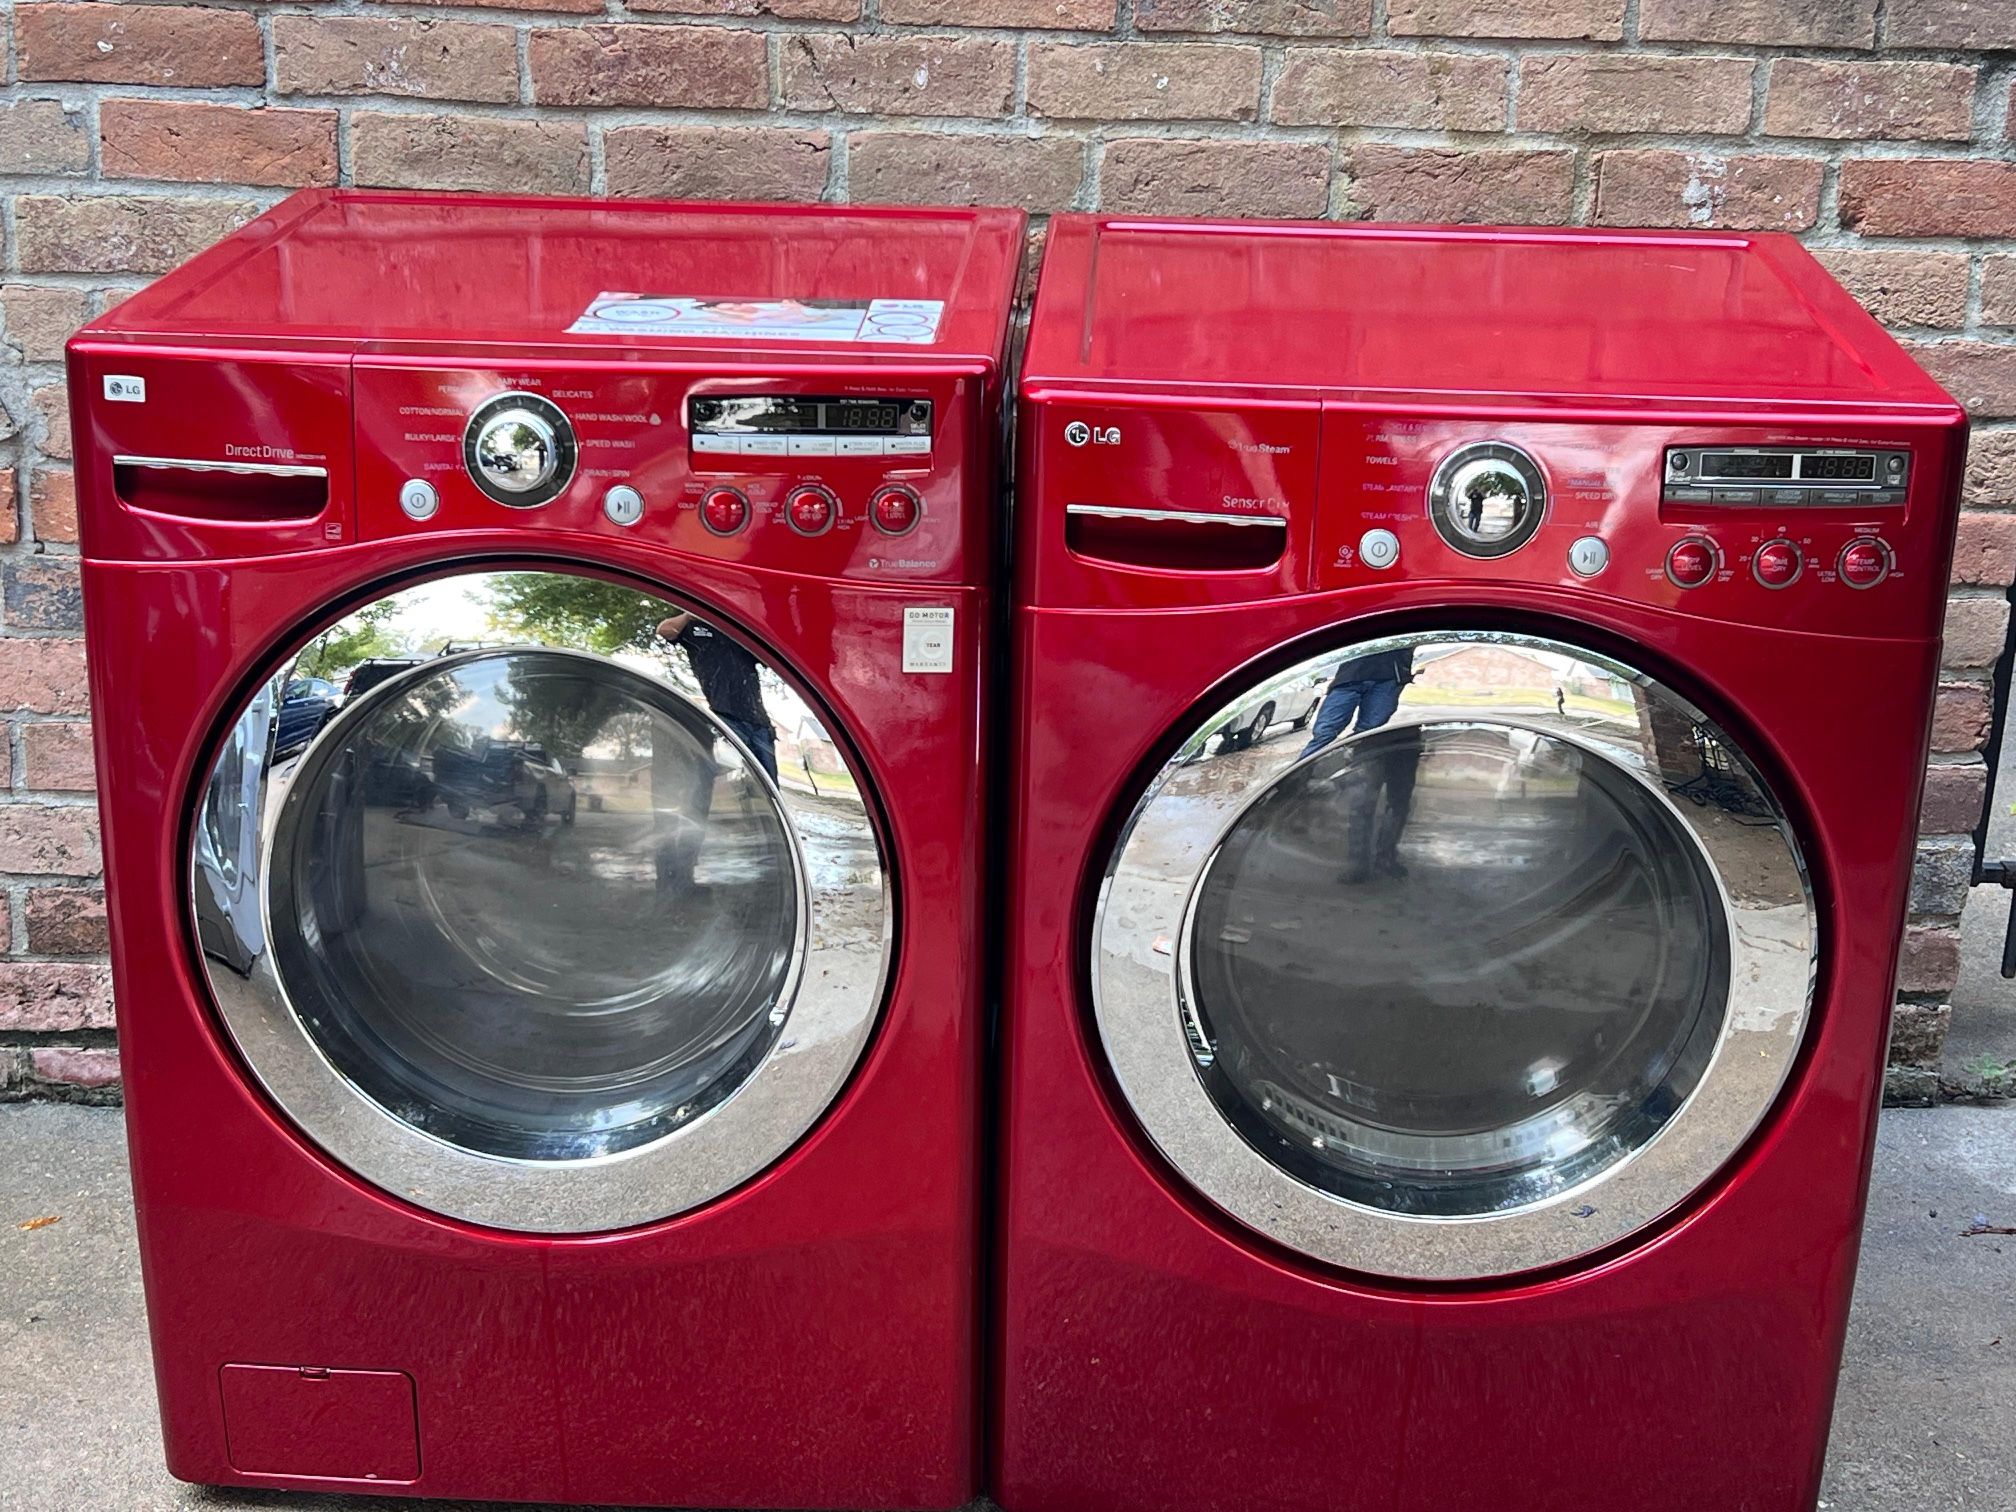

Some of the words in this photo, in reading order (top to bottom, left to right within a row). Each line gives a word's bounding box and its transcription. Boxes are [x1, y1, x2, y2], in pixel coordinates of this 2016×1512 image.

[125, 385, 141, 395] LG
[552, 390, 593, 399] DELICATES
[575, 413, 597, 421] HAND
[1093, 426, 1121, 445] LG
[586, 439, 611, 448] SPEED
[612, 440, 635, 448] WASH
[1365, 456, 1398, 465] TOWELS
[1575, 491, 1600, 500] SPEED
[1222, 495, 1265, 509] Sensor
